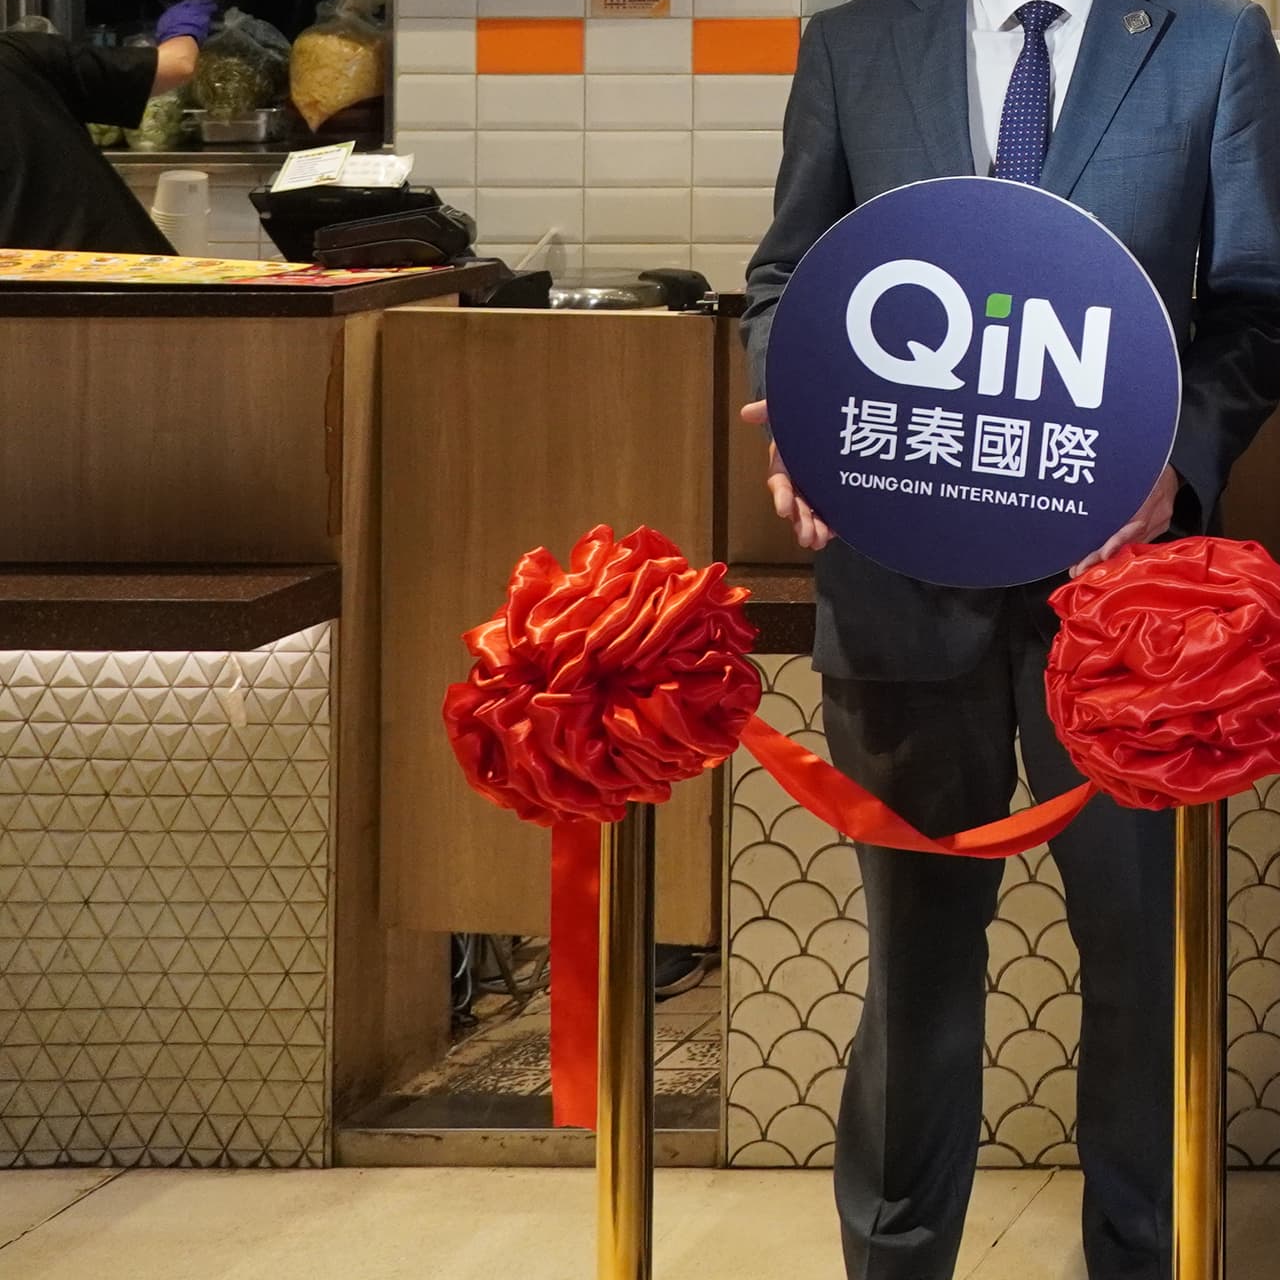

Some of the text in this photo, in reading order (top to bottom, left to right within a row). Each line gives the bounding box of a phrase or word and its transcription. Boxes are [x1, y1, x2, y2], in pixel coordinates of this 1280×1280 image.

[839, 396, 1100, 485] 揚秦國際
[839, 470, 1089, 516] YOUNGQIN INTERNATIONAL
